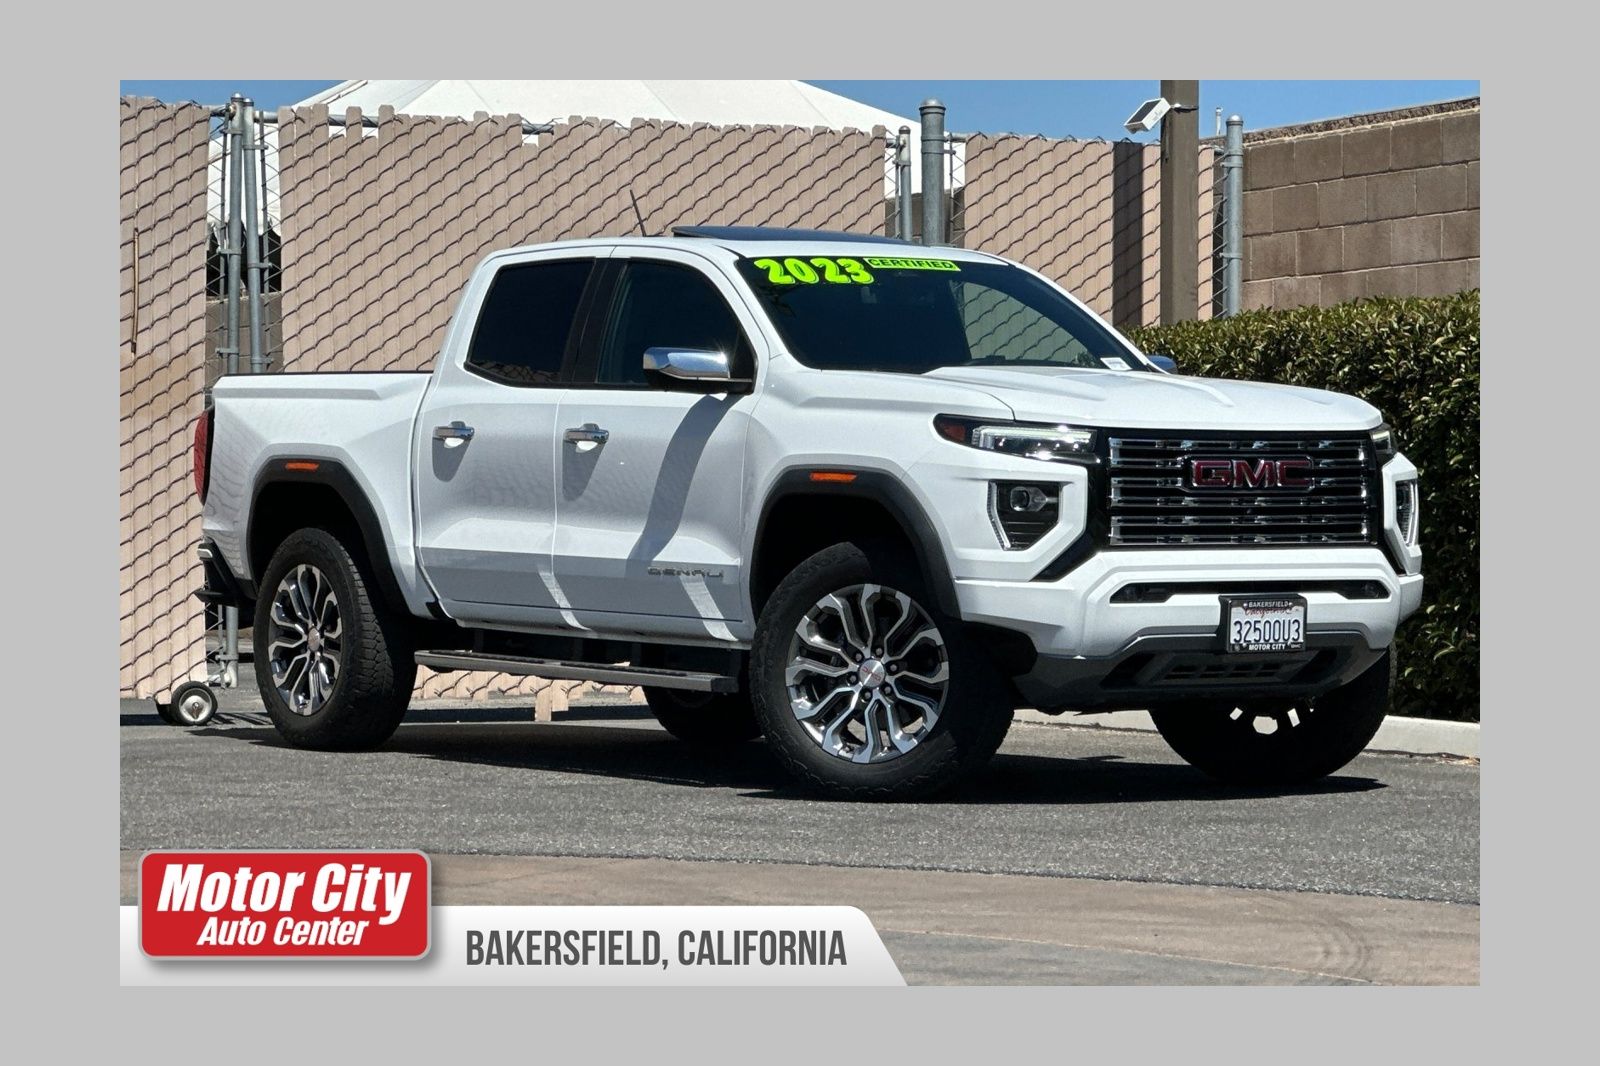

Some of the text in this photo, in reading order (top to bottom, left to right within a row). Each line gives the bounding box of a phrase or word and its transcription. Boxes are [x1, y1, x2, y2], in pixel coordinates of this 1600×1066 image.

[754, 257, 875, 285] 2023
[867, 258, 954, 270] CERTIFIED
[1191, 459, 1316, 488] GMC
[1233, 619, 1300, 643] 32500U3
[1249, 643, 1270, 651] MOTOR
